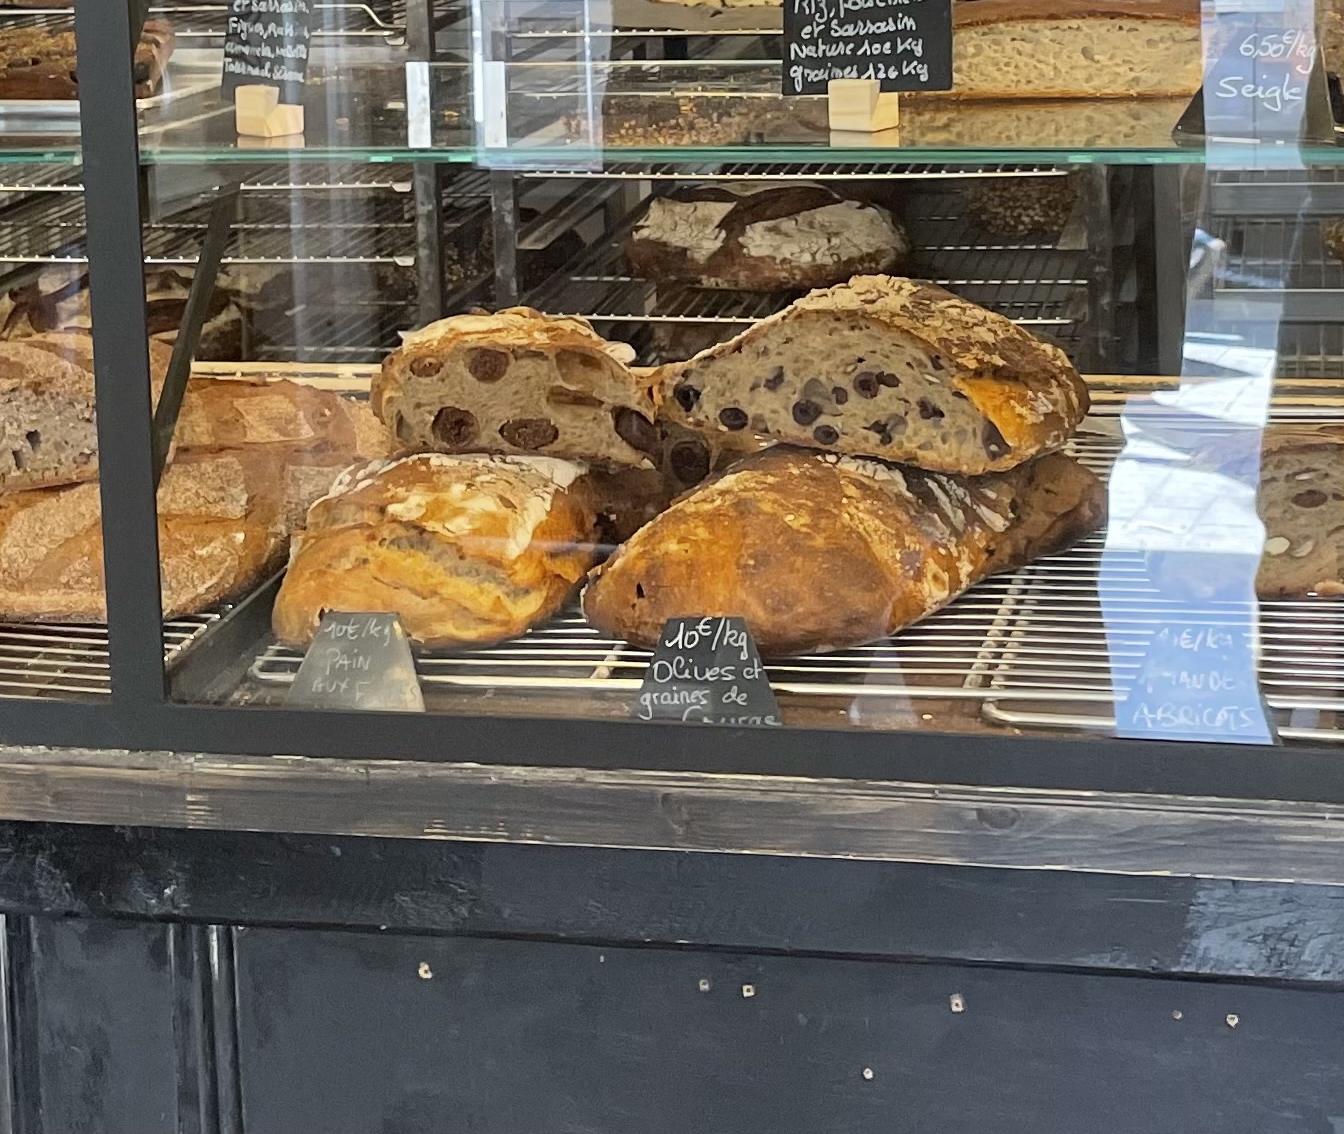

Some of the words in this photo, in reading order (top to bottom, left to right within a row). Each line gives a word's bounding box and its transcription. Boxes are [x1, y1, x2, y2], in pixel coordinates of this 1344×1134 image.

[800, 21, 826, 40] et
[790, 38, 855, 61] Nature
[1239, 29, 1317, 75] 6,50€/kg
[789, 62, 859, 93] graines
[1215, 72, 1303, 112] Seigle
[324, 617, 392, 647] 10€/kg
[665, 616, 749, 661] 10€/kg
[652, 655, 738, 684] Olives
[743, 657, 764, 680] et
[639, 686, 711, 721] graines
[721, 685, 748, 706] de
